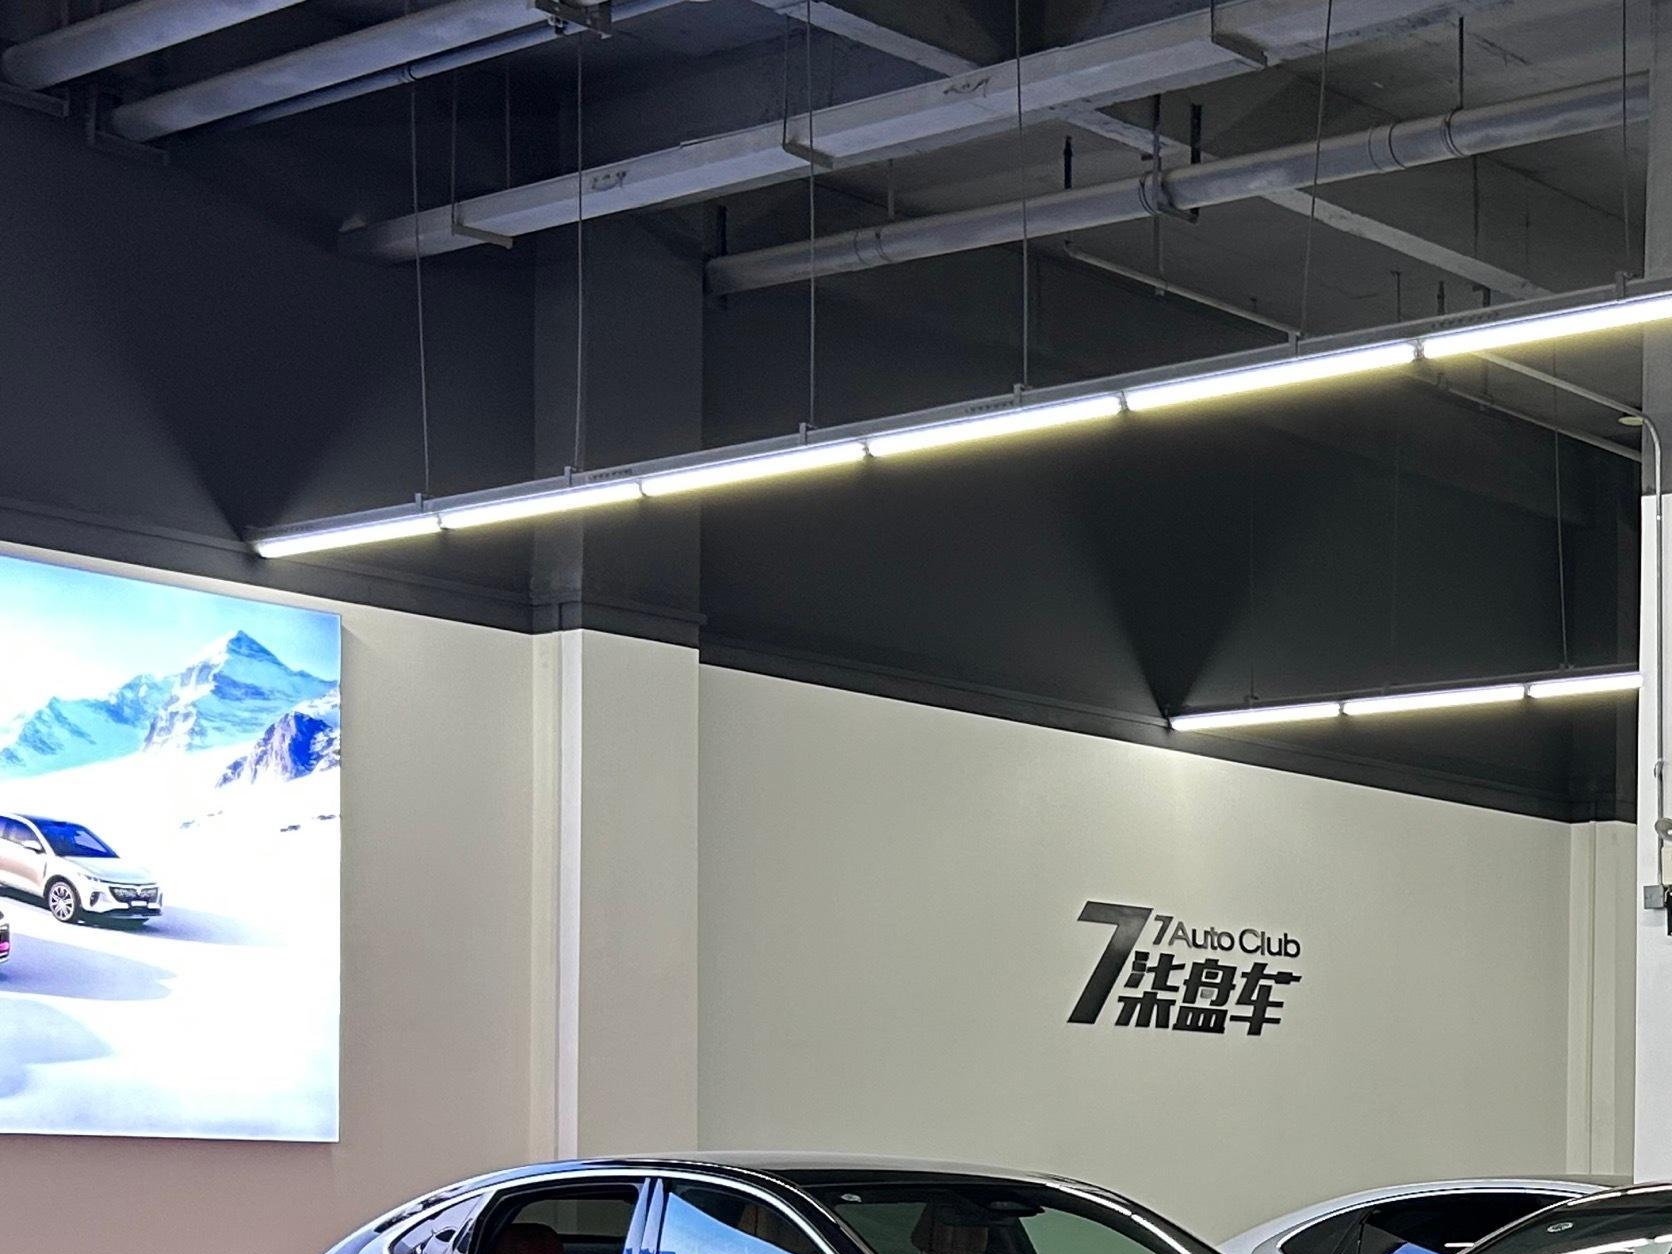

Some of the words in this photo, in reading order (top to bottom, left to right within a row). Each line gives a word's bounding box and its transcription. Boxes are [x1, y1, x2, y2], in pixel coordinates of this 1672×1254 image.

[1238, 928, 1301, 959] Club
[1115, 950, 1302, 1037] 柒盘车
